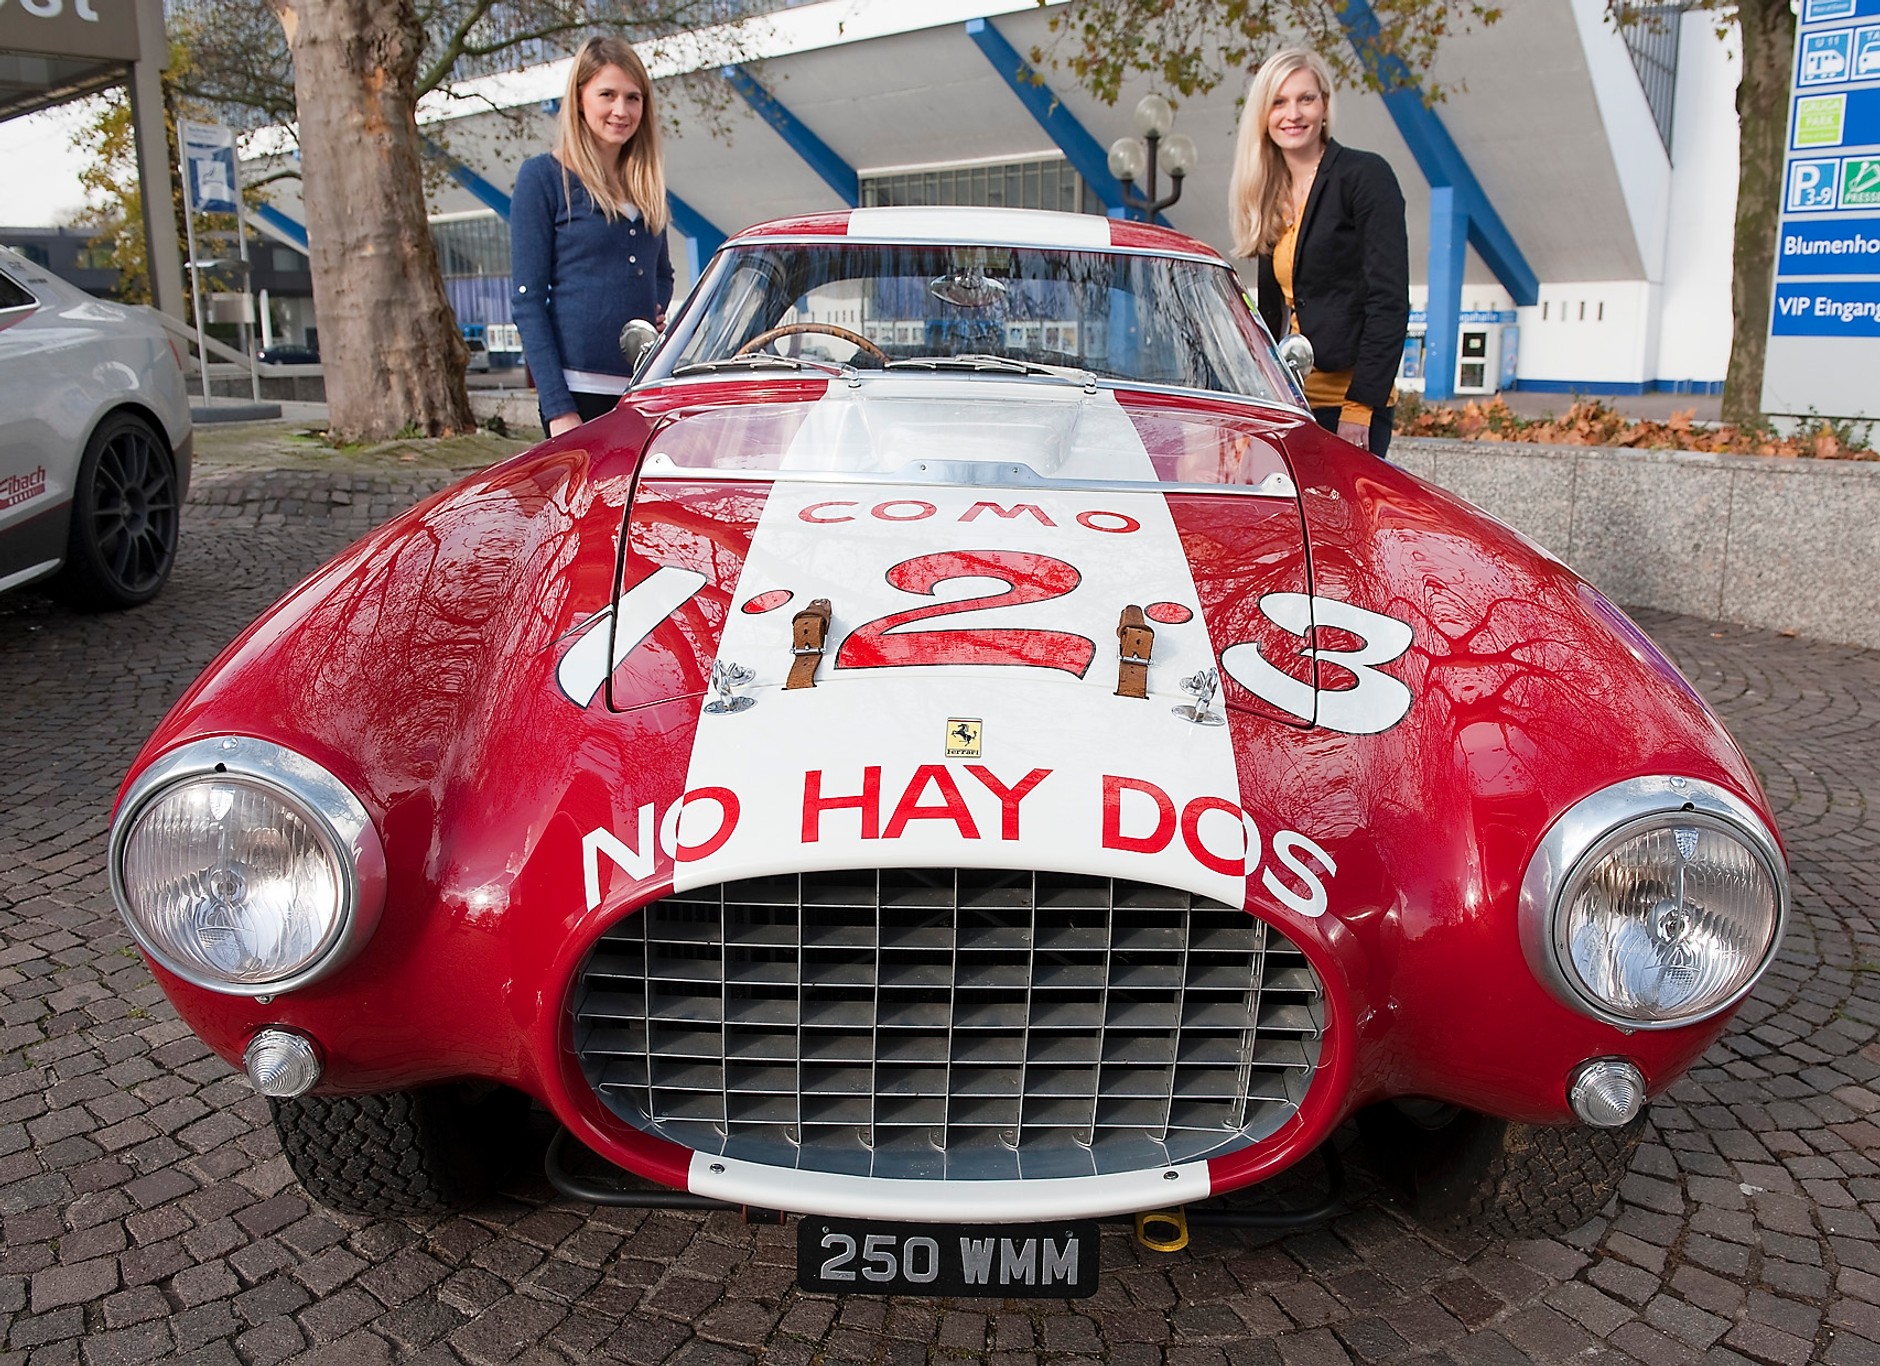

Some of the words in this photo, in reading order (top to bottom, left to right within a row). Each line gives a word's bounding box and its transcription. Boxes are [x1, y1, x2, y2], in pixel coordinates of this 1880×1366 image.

[1793, 165, 1820, 206] P
[1804, 187, 1832, 206] 3-9
[1783, 233, 1880, 256] Blumenho
[1778, 296, 1811, 316] VIP
[798, 500, 1141, 534] COMO
[834, 549, 1097, 680] 2
[1219, 591, 1416, 735] 3
[946, 748, 980, 756] Ferrari
[582, 786, 741, 913] NO
[800, 764, 1054, 844] HAY
[1101, 774, 1338, 918] DOS
[819, 1233, 940, 1283] 250
[959, 1237, 1080, 1286] WMM
